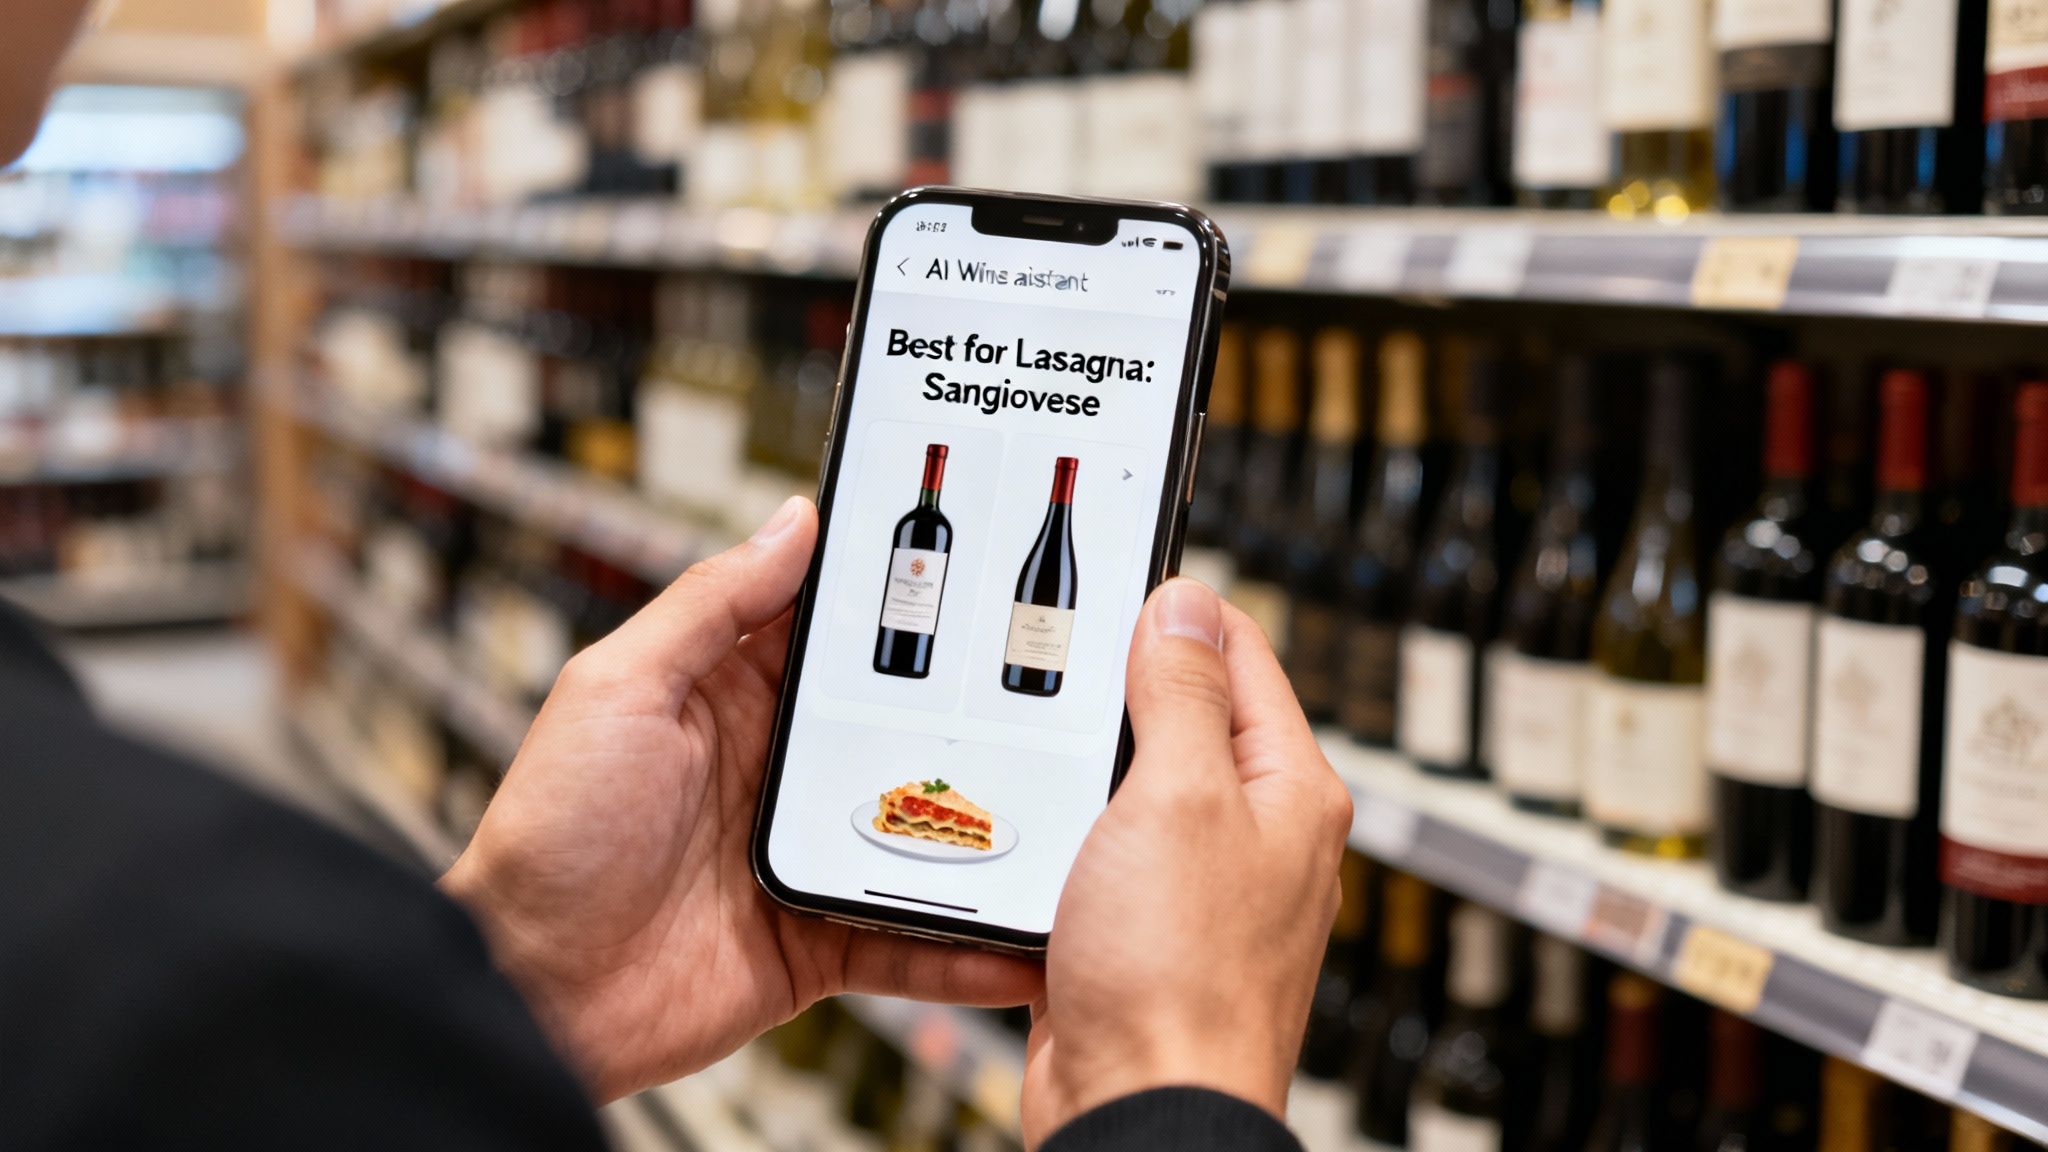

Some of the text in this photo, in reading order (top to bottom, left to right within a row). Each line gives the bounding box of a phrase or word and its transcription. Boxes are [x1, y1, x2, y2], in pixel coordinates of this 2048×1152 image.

[925, 257, 949, 281] AI
[886, 328, 1155, 384] Best for Lasagna:
[922, 372, 1101, 417] Sangiovese
